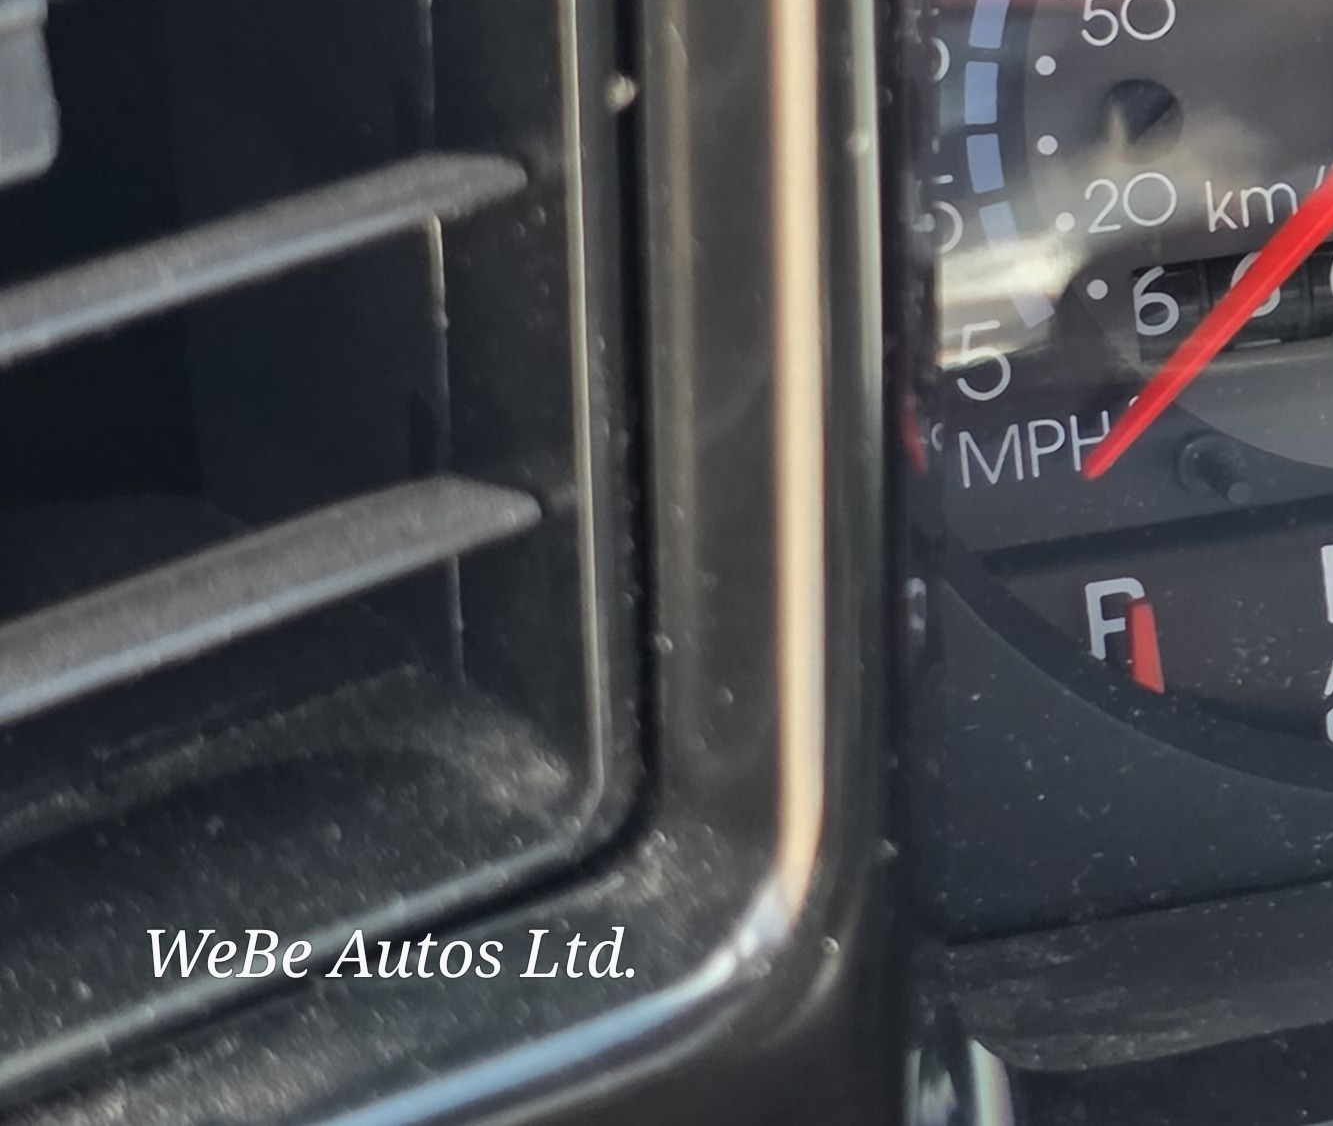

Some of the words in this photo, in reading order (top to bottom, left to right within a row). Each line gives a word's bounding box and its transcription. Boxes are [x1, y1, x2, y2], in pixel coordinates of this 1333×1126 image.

[1084, 172, 1177, 234] 20
[956, 320, 1012, 402] 5
[957, 409, 1111, 489] MPH
